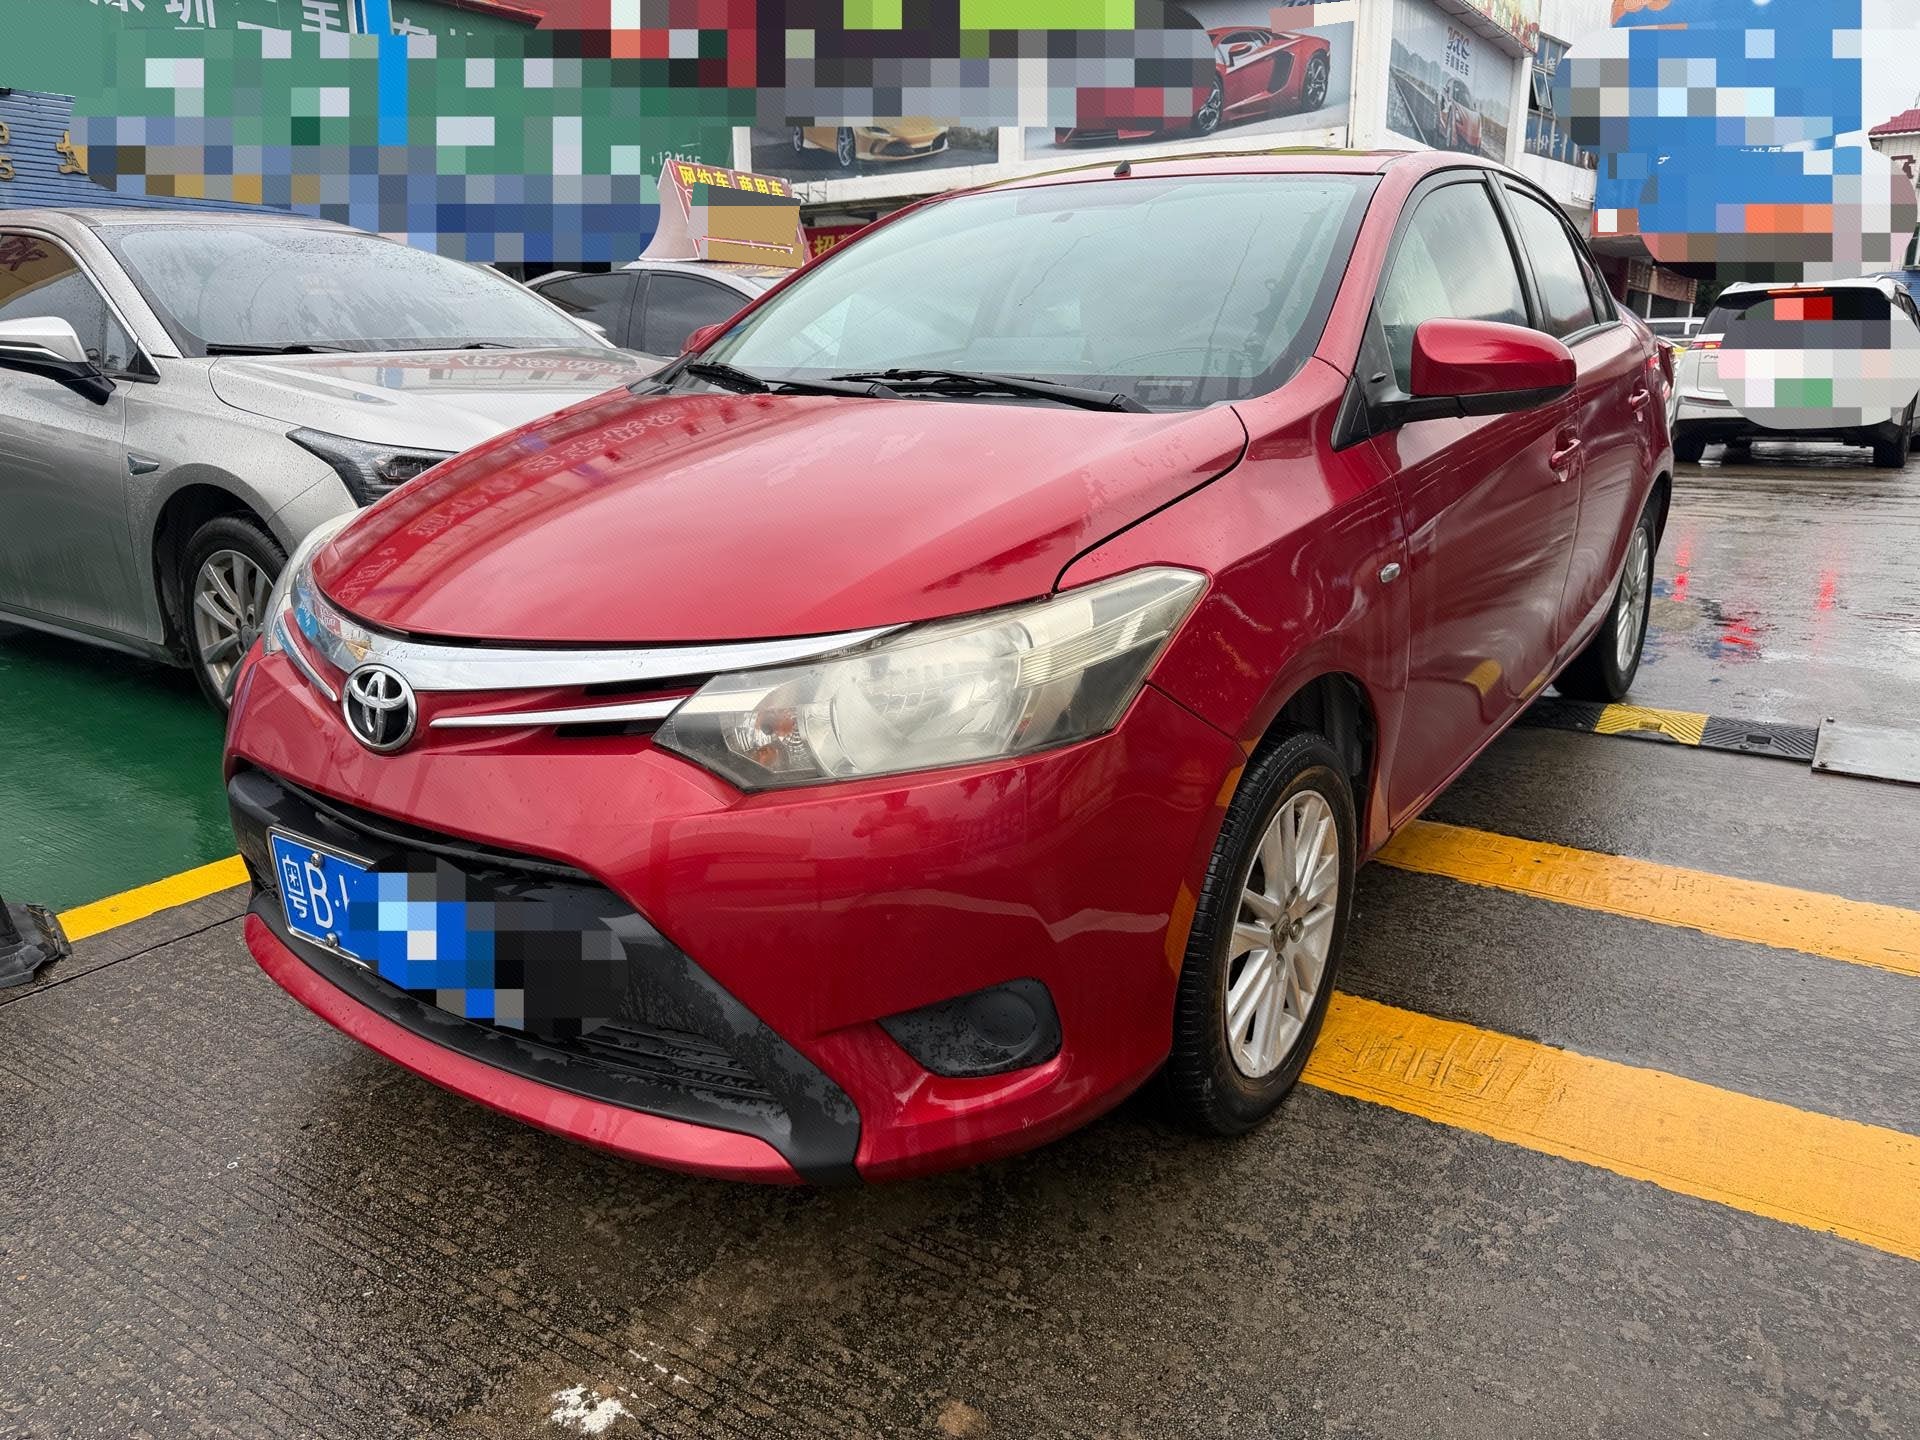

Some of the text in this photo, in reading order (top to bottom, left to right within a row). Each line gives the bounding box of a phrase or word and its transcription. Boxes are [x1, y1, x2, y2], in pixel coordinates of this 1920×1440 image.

[677, 165, 786, 197] 网约车 商用车
